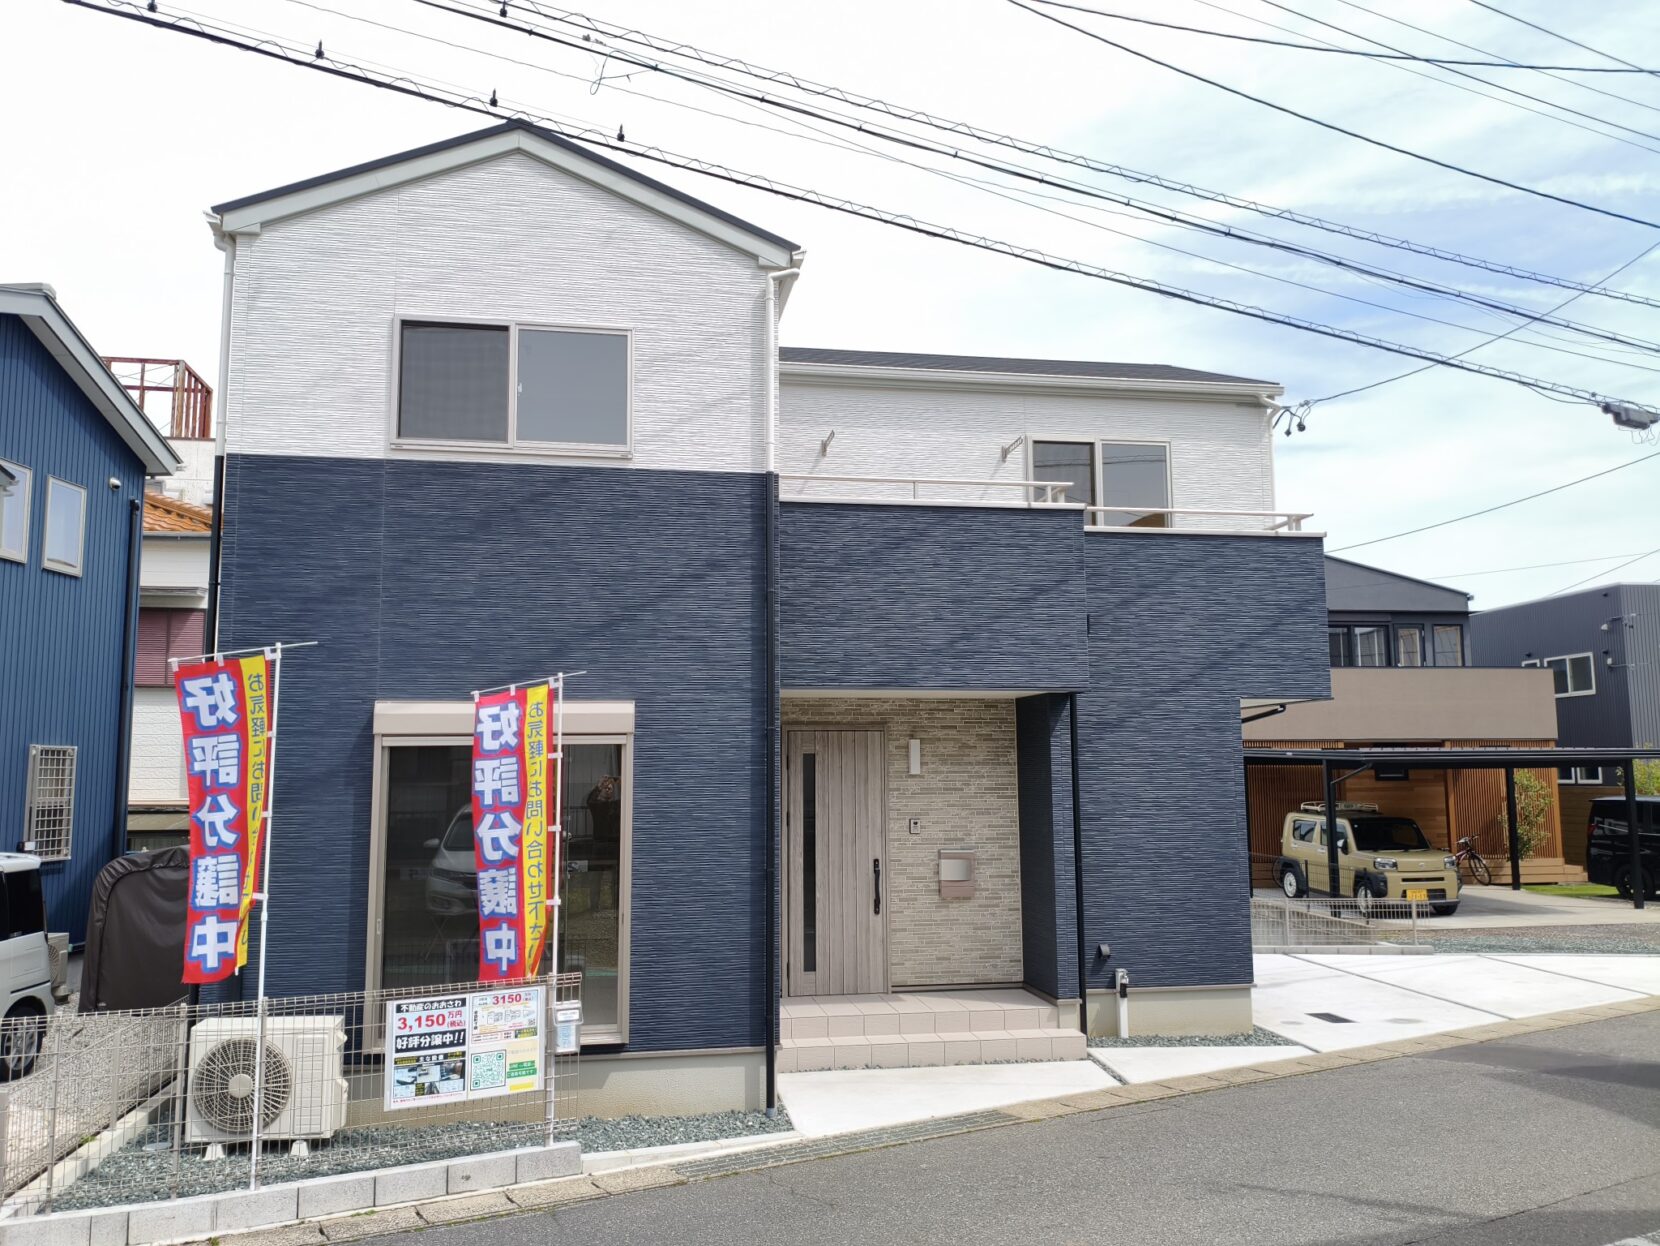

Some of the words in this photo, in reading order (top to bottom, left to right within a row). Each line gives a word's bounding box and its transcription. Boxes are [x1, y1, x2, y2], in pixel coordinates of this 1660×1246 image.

[400, 1000, 462, 1012] 不動産のおおさわ
[492, 993, 522, 1005] 3150
[397, 1013, 446, 1032] 3,150
[447, 1010, 463, 1019] 万円
[396, 1031, 465, 1050] 好評分譲中!!
